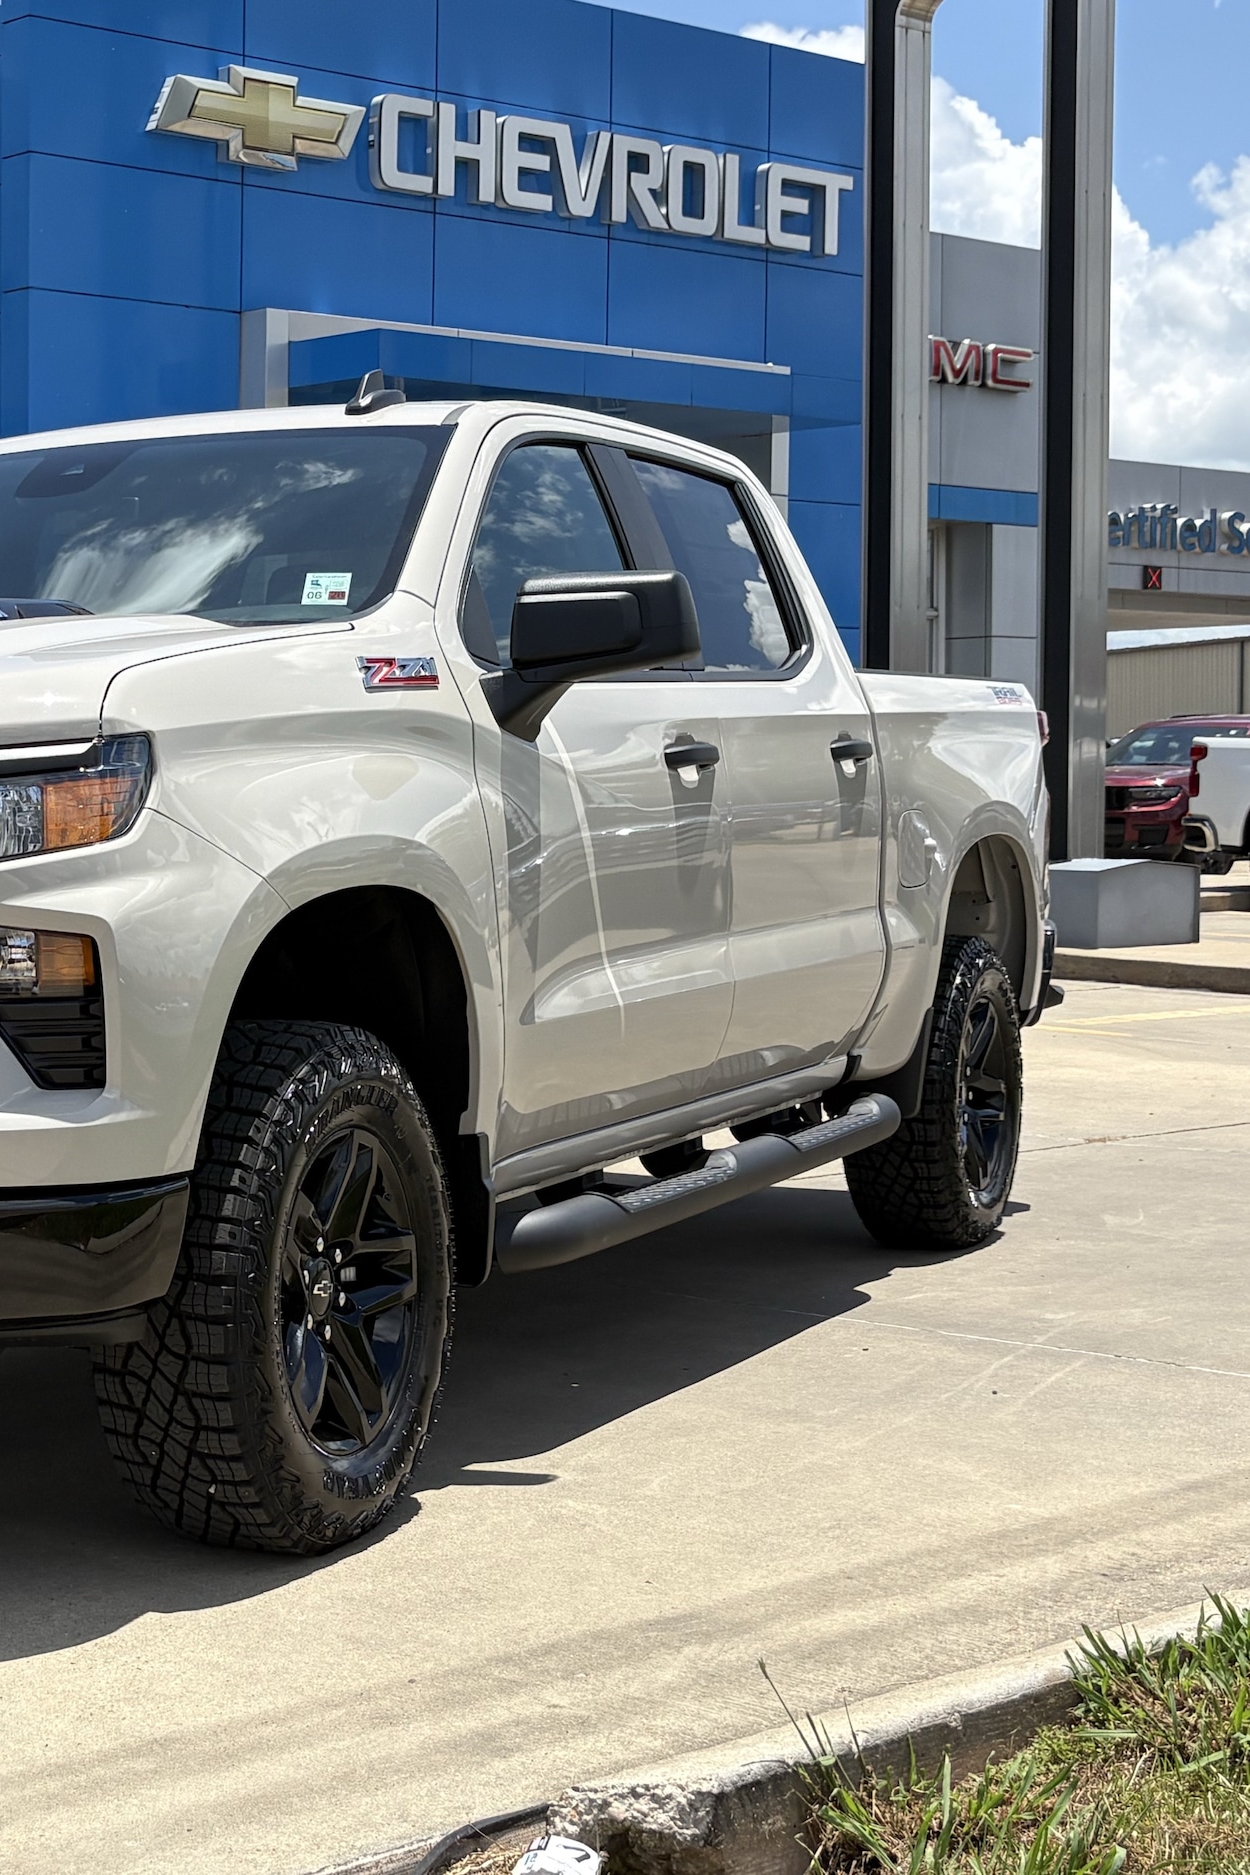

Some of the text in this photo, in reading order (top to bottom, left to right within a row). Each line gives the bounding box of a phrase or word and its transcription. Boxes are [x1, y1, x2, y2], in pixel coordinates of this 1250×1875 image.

[368, 93, 854, 257] CHEVROLET
[927, 335, 1034, 393] MC
[1108, 502, 1250, 555] ertified S
